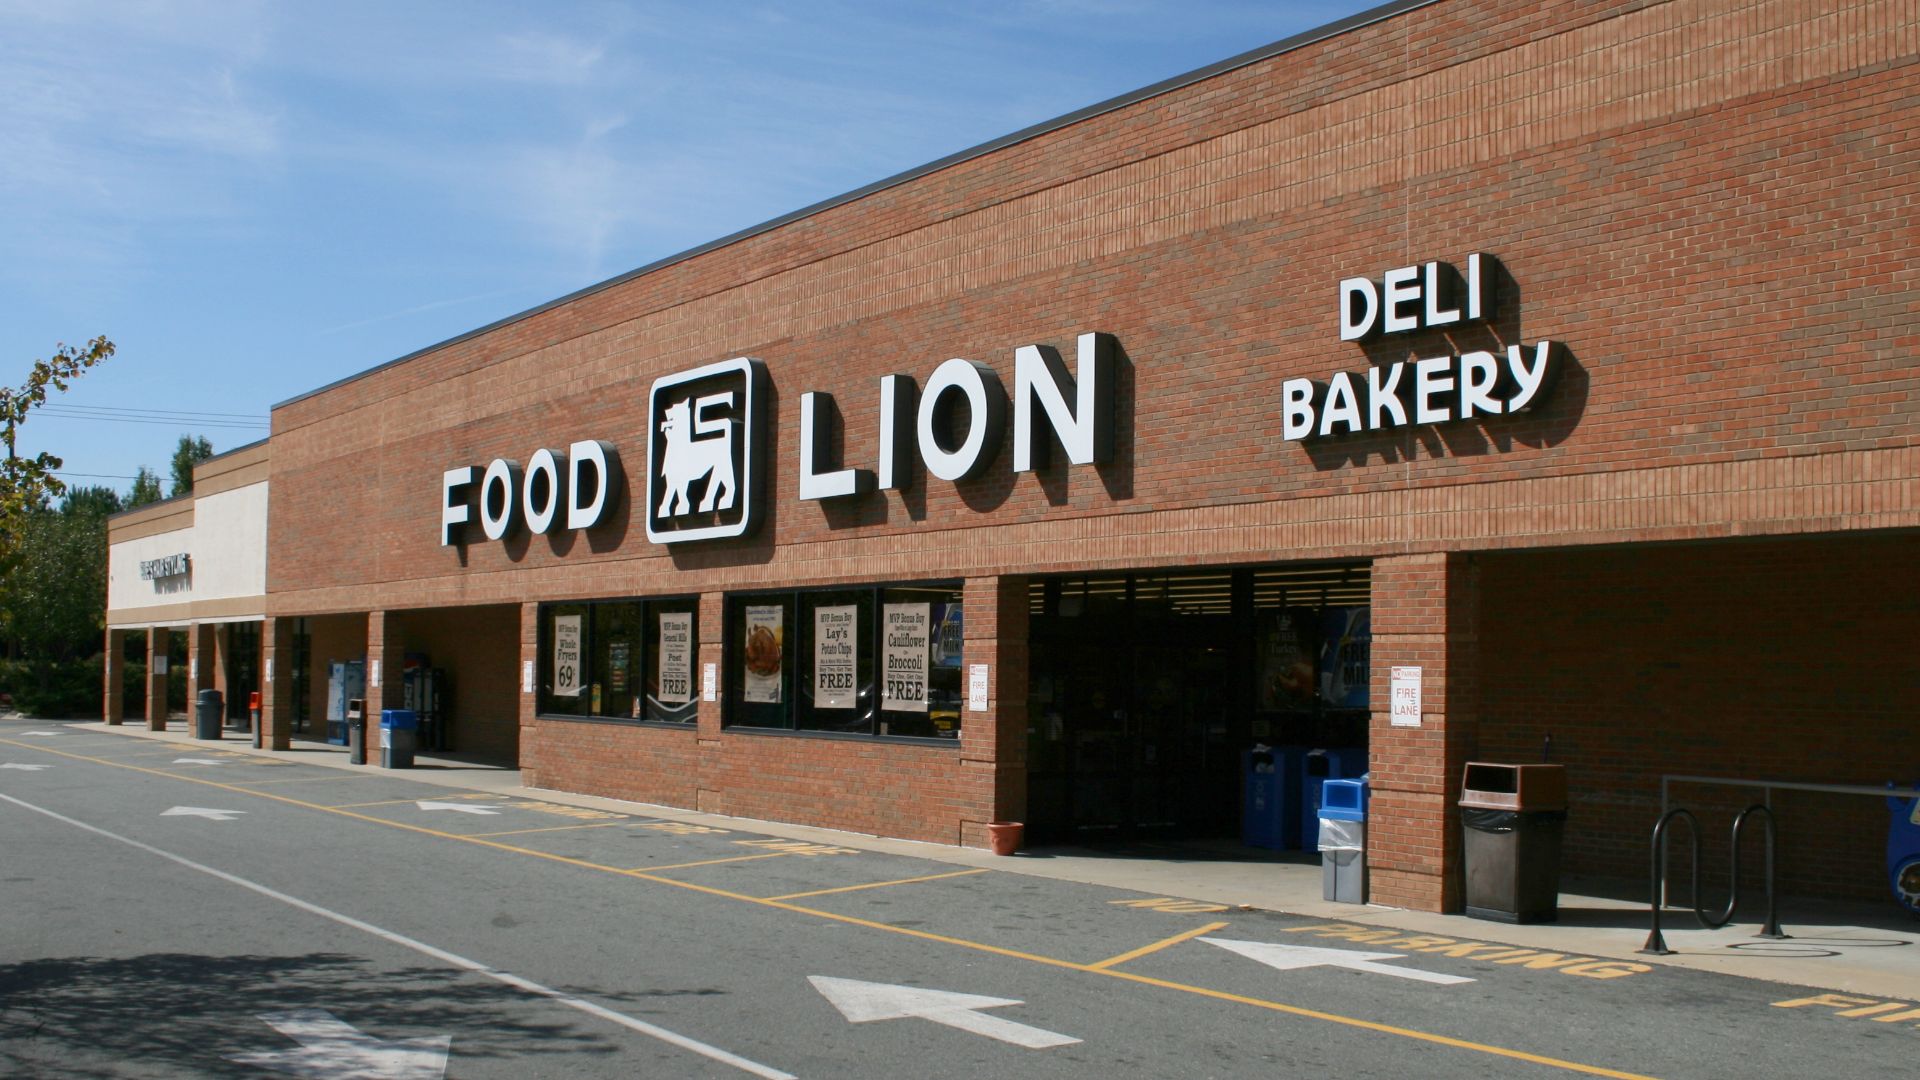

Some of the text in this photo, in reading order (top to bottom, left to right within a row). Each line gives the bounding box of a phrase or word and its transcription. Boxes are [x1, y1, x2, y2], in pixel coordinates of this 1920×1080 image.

[1339, 252, 1481, 341] DELI
[1282, 341, 1550, 441] BAKERY
[441, 331, 1096, 547] FOOD LION
[889, 612, 925, 626] MVP Bonus Buy
[826, 627, 848, 641] Lay's
[888, 633, 926, 647] Cauliflower
[560, 640, 576, 649] Whole
[821, 642, 852, 658] Potato Chips
[558, 649, 577, 663] Fryers
[668, 653, 682, 661] Post
[888, 654, 923, 669] Broccoli
[663, 680, 687, 695] FREE
[819, 673, 853, 689] FREE
[972, 681, 985, 690] FIRE
[887, 681, 924, 701] FREE
[1396, 688, 1417, 699] FIRE
[971, 695, 986, 703] LANE
[1394, 705, 1419, 716] LANE
[1106, 897, 1231, 913] NO
[1280, 923, 1654, 979] PARKING
